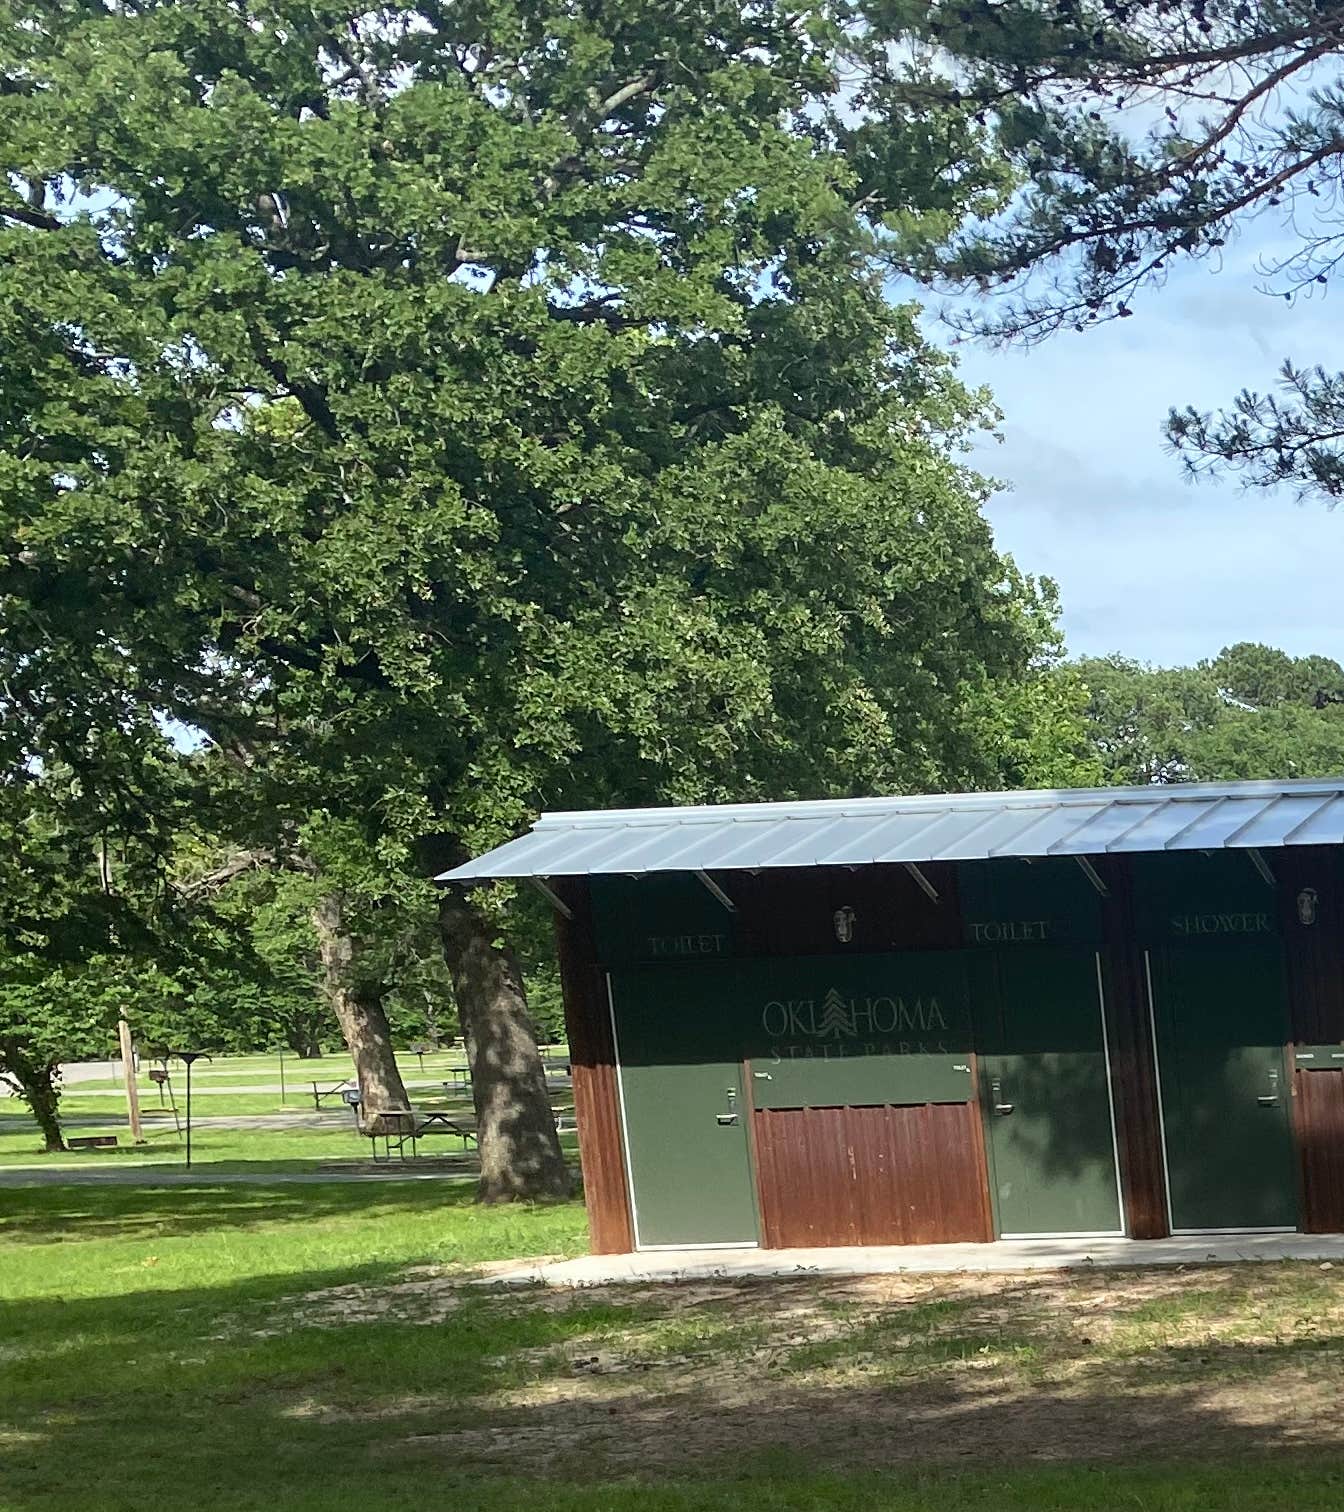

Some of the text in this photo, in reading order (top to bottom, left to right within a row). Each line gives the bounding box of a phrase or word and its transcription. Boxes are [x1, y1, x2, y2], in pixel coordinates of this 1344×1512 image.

[968, 921, 1049, 941] TOILET
[1170, 912, 1272, 933] SHOWER
[648, 933, 721, 953] TOILET
[770, 1041, 952, 1064] STATE PARKS
